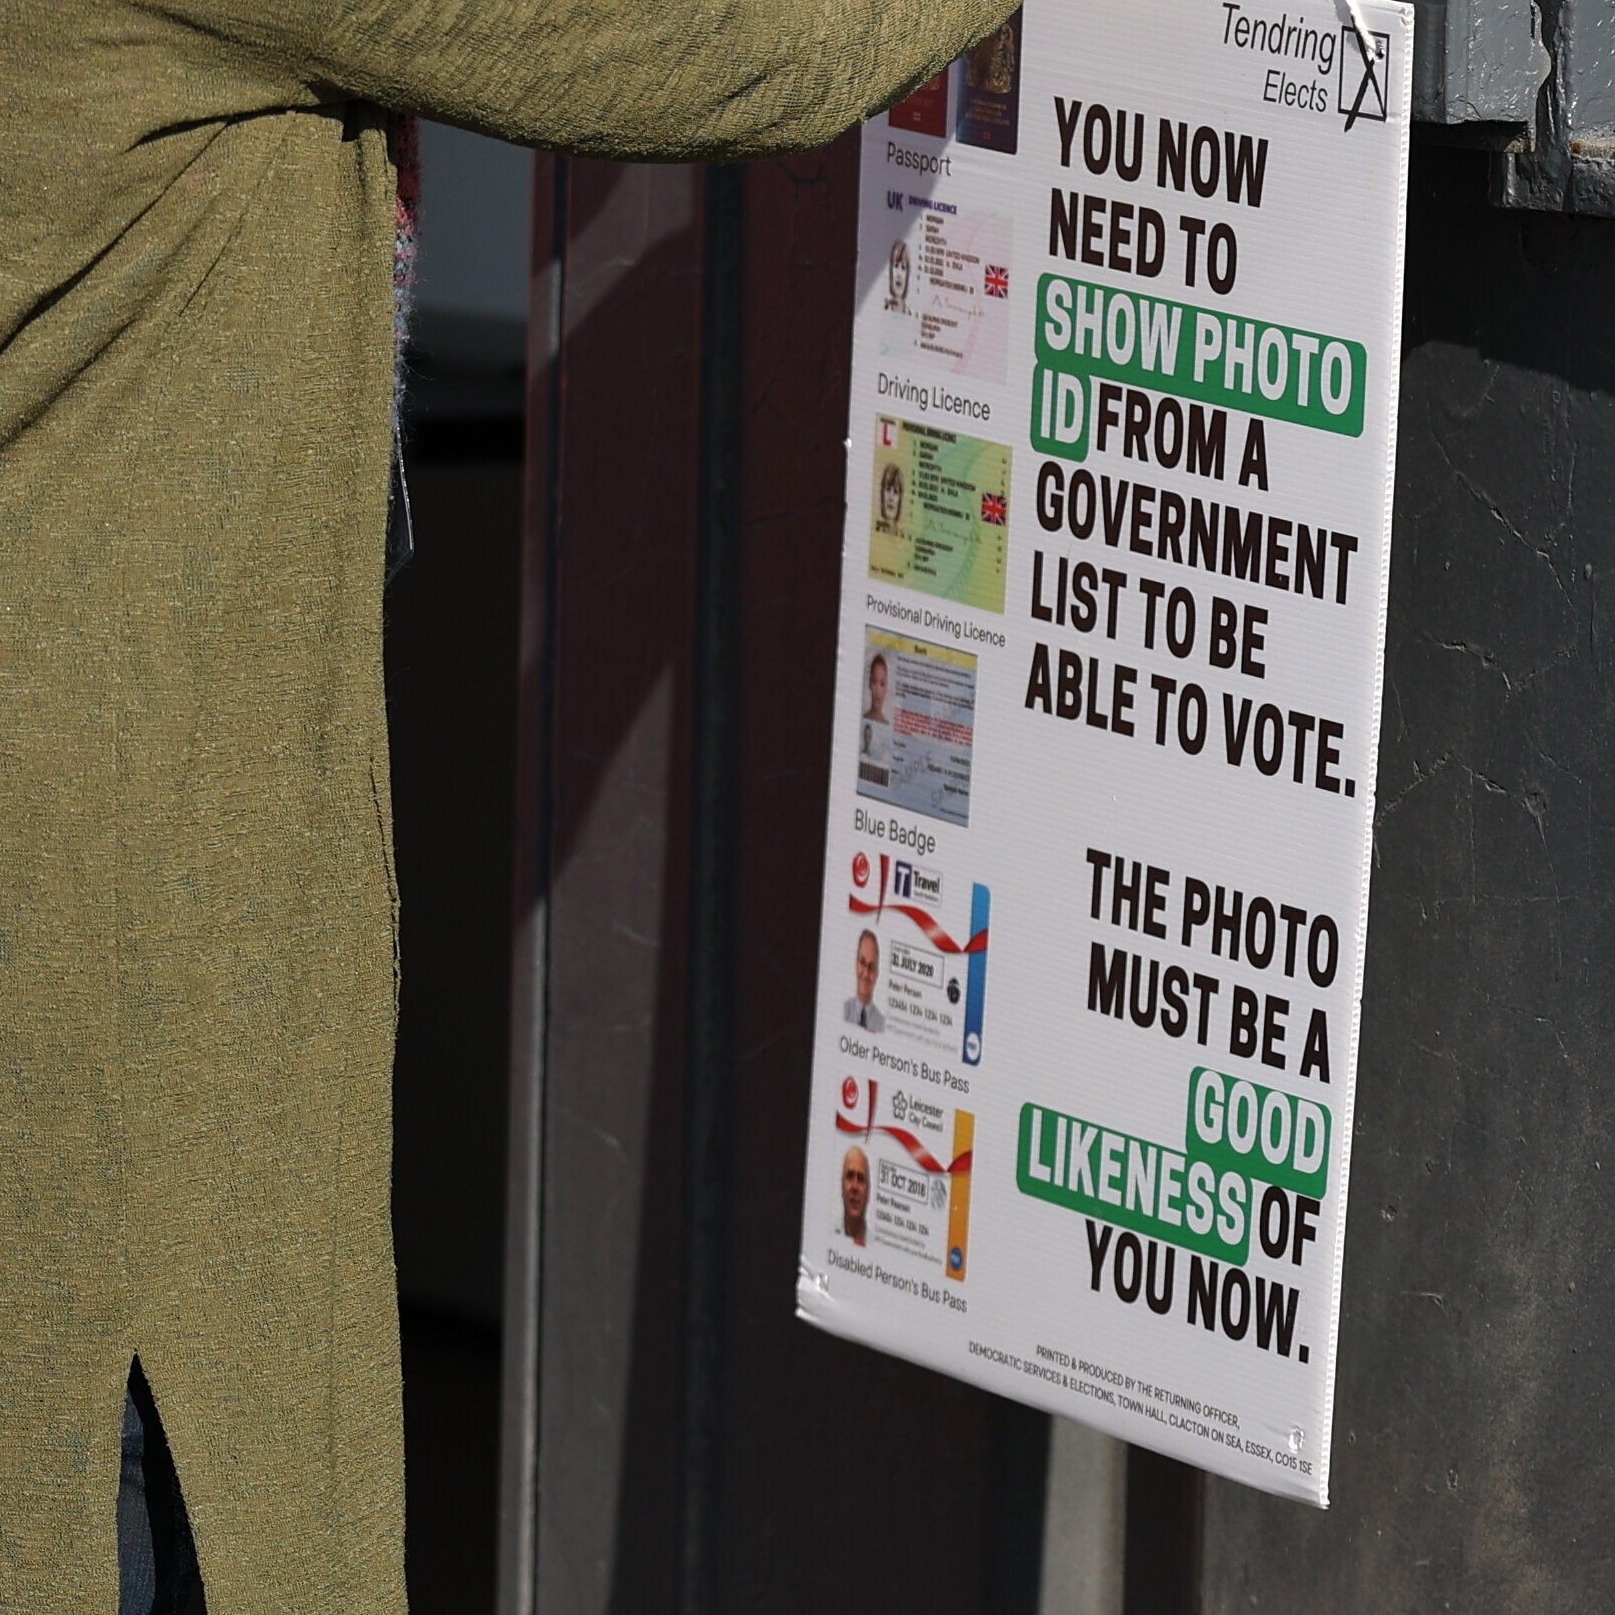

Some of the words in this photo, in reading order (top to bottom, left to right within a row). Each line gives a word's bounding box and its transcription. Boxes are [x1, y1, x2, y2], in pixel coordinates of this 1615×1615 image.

[1222, 2, 1336, 74] Tendring
[1263, 69, 1327, 112] Elects
[887, 141, 951, 176] Passport
[1053, 95, 1144, 182] YOU
[1156, 117, 1268, 208] NOW
[886, 190, 905, 213] UK
[1049, 187, 1165, 278] NEED
[1179, 215, 1237, 294] TO
[1044, 278, 1182, 376] SHOW
[1193, 311, 1352, 414] PHOTO
[877, 372, 928, 409] Driving
[932, 386, 990, 421] Licence
[1040, 368, 1084, 443] ID
[1096, 382, 1227, 480] FROM
[1238, 417, 1268, 491] A
[1036, 461, 1358, 603] GOVERNMENT
[866, 594, 922, 624] Provisional
[924, 610, 961, 638] Driving
[963, 621, 1005, 647] Licence
[1030, 549, 1127, 640] LIST
[1139, 577, 1195, 659] TO
[1208, 595, 1268, 679] BE
[1024, 643, 1137, 737] ABLE
[1150, 673, 1207, 755] TO
[1222, 692, 1355, 798] VOTE.
[854, 809, 885, 838] Blue
[889, 818, 935, 854] Badge
[913, 870, 941, 894] Travel
[1086, 847, 1170, 940] THE
[1181, 875, 1339, 987] PHOTO
[1087, 942, 1219, 1046] MUST
[1229, 984, 1290, 1070] BE
[1299, 1007, 1330, 1084] A
[839, 1037, 870, 1059] Older
[871, 1046, 918, 1077] Person's
[920, 1061, 941, 1084] Bus
[943, 1069, 969, 1094] Pass
[909, 1097, 945, 1118] Leicester
[1194, 1071, 1325, 1173] GOOD
[1028, 1109, 1246, 1244] LIKENESS
[1259, 1186, 1320, 1264] OF
[827, 1250, 873, 1279] Disabled
[874, 1265, 919, 1295] Person's
[920, 1281, 940, 1303] Bus
[942, 1289, 967, 1313] Pass
[1085, 1220, 1175, 1315] YOU
[1187, 1254, 1309, 1364] NOW.
[968, 1341, 1022, 1370] DEMOCRATIC
[1023, 1360, 1061, 1385] SERVICES
[1062, 1374, 1068, 1387] &
[1069, 1377, 1116, 1406] ELECTIONS,
[1117, 1394, 1144, 1414] TOWN
[1144, 1404, 1167, 1425] HALL,
[1168, 1413, 1209, 1438] CLACTON
[1210, 1428, 1224, 1444] ON
[1225, 1433, 1243, 1452] SEA,
[1245, 1440, 1273, 1462] ESSEX,
[1274, 1450, 1297, 1470] CO15
[1298, 1459, 1312, 1475] 1SE
[1036, 1345, 1070, 1367] PRINTED
[1071, 1357, 1077, 1370] &
[1078, 1359, 1123, 1386] PRODUCED
[1124, 1376, 1136, 1390] BY
[1137, 1380, 1152, 1397] THE
[1154, 1386, 1201, 1414] RETURNING
[1202, 1404, 1240, 1430] OFFICER,
